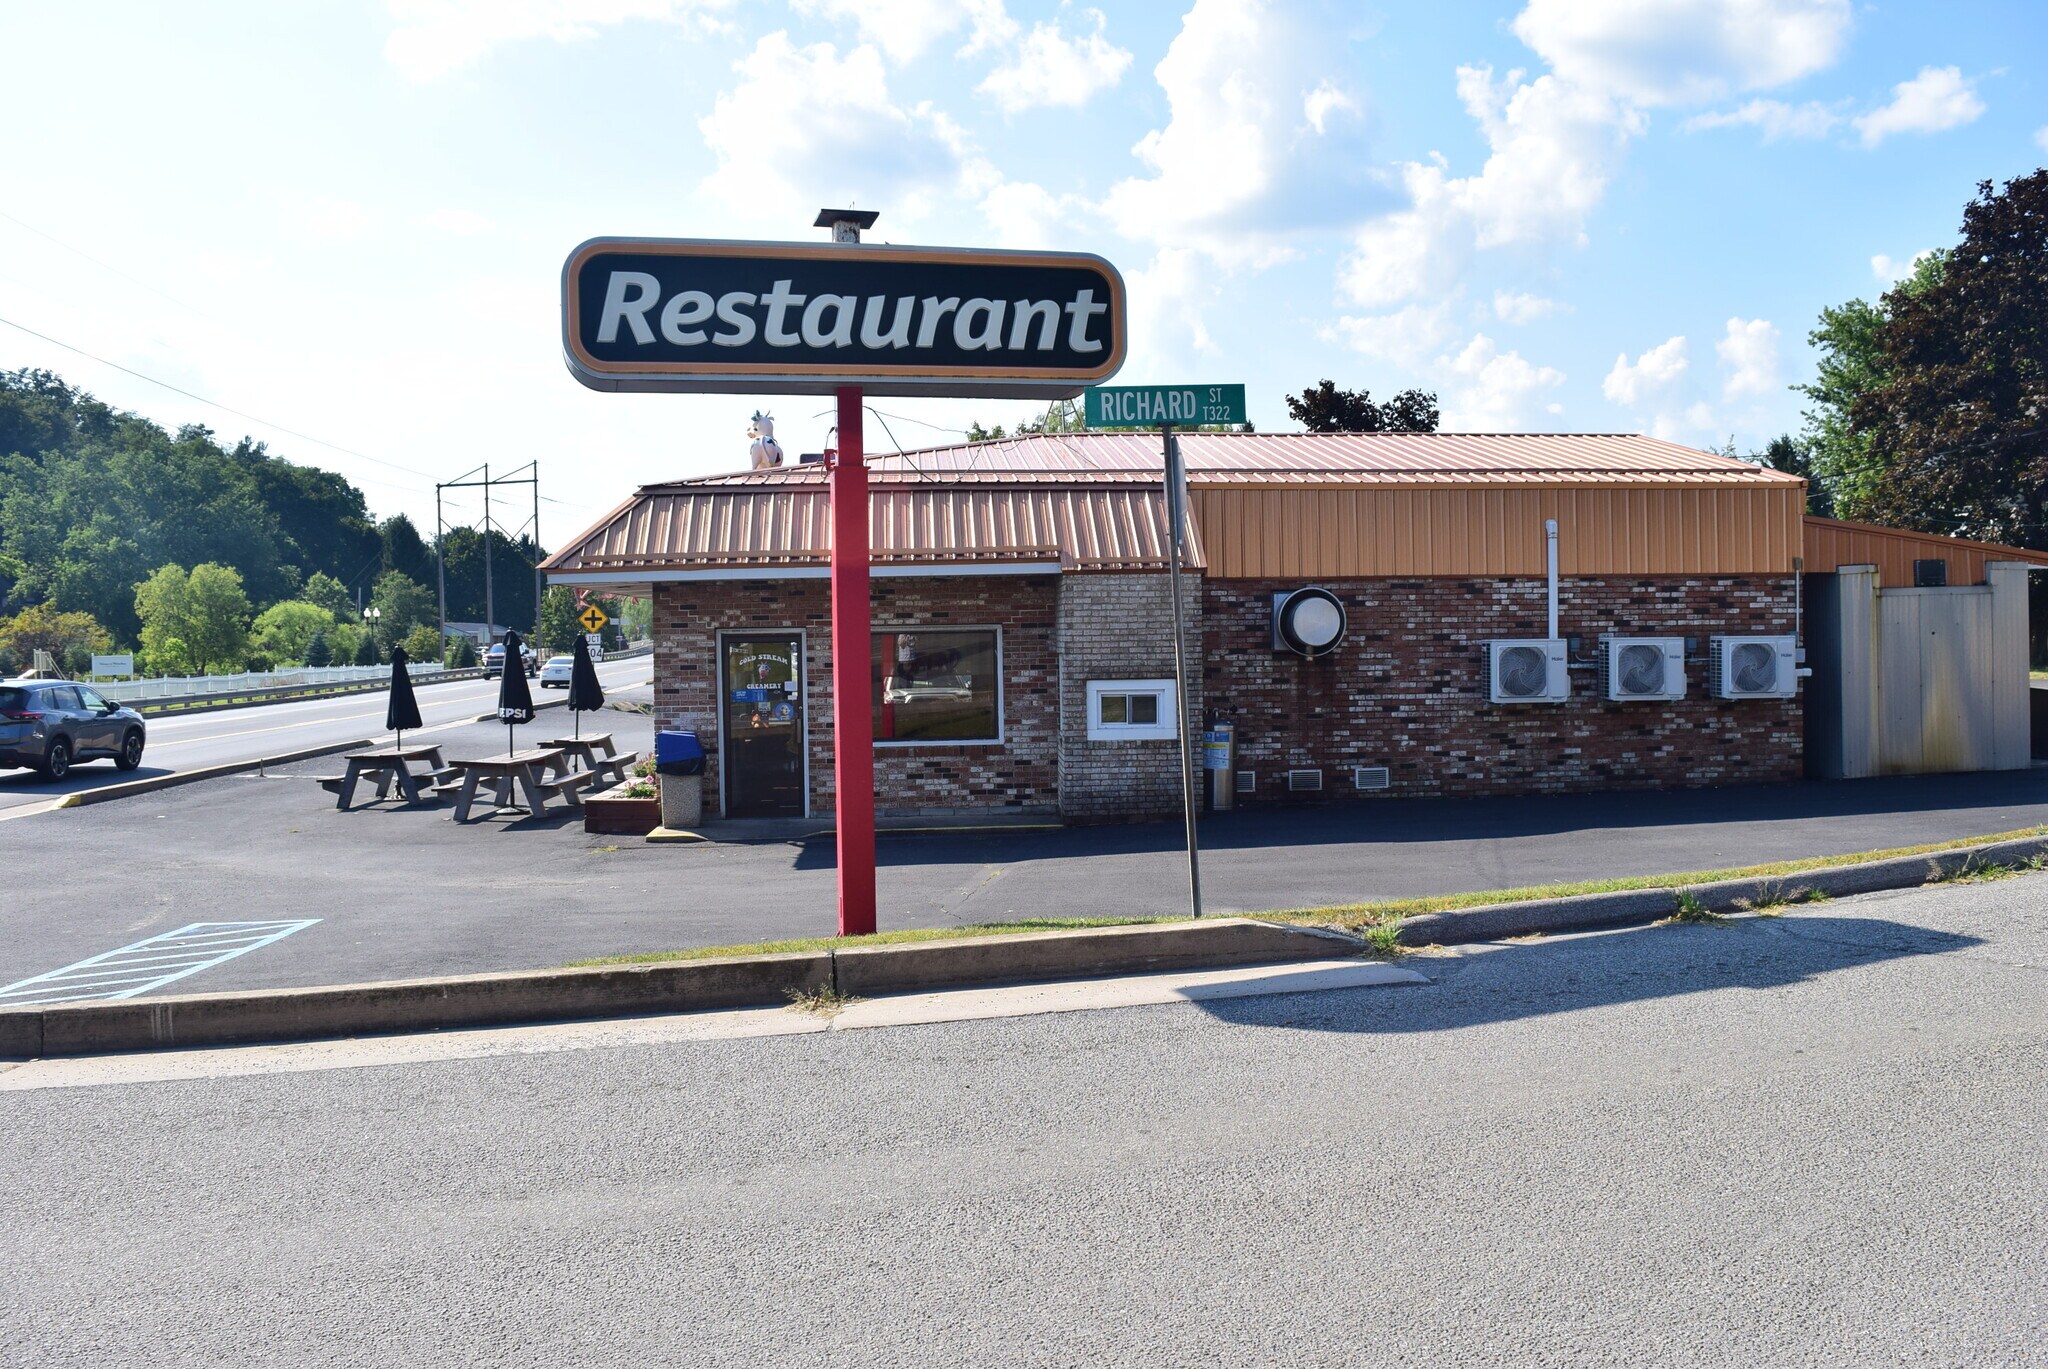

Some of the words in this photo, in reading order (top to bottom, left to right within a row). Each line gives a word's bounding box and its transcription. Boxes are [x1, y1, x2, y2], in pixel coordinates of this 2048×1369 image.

[596, 270, 1108, 353] Restaurant
[1101, 391, 1197, 421] RICHARD
[1209, 387, 1222, 403] ST
[1203, 405, 1230, 421] T322
[587, 635, 600, 643] JCT
[588, 648, 602, 658] 04
[739, 655, 756, 666] COLD
[758, 654, 788, 665] STREAM
